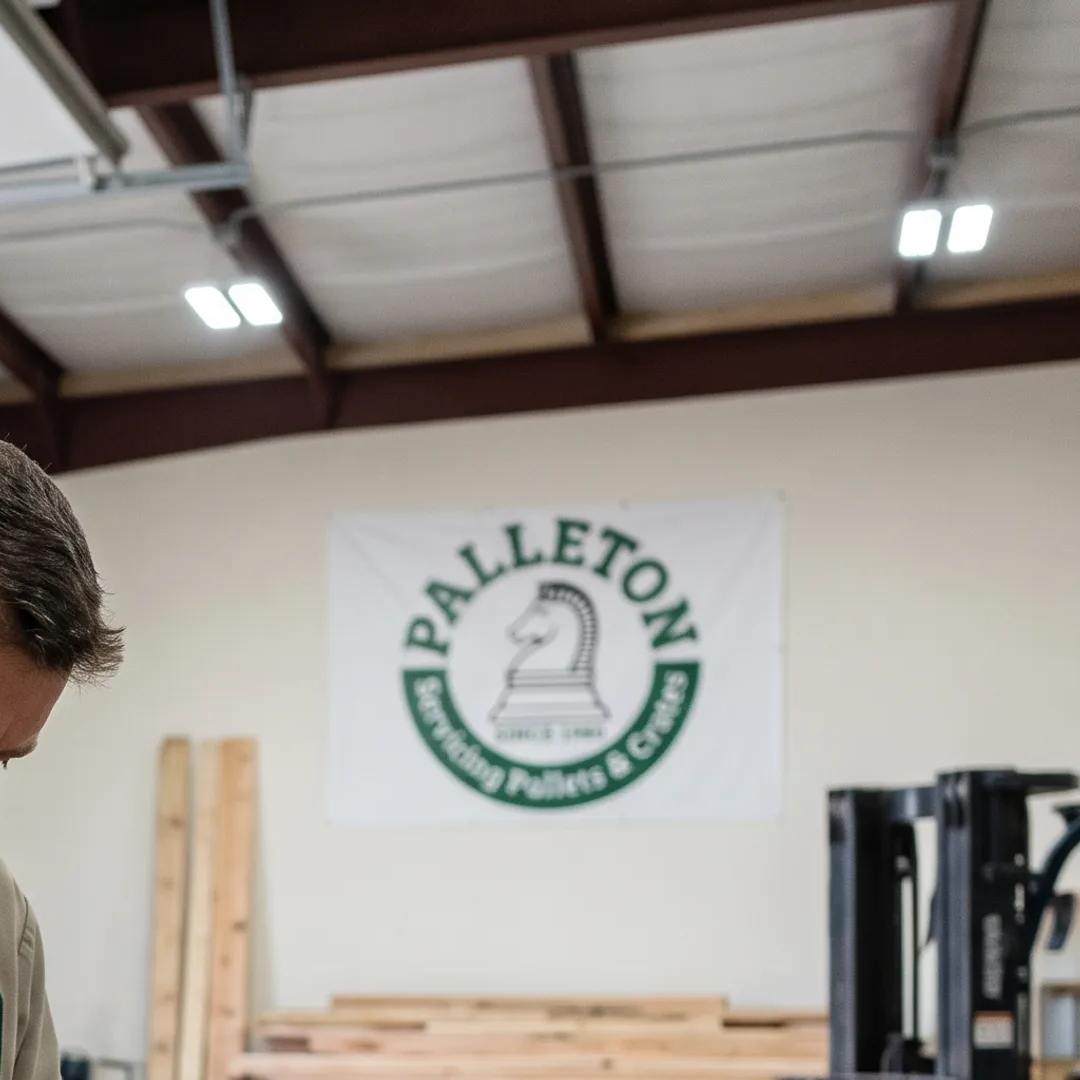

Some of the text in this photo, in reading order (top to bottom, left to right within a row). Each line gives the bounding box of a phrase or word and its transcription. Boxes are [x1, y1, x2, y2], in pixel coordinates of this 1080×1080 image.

[404, 517, 698, 656] PALLETON
[414, 669, 690, 800] Servicing Pallets & Crates
